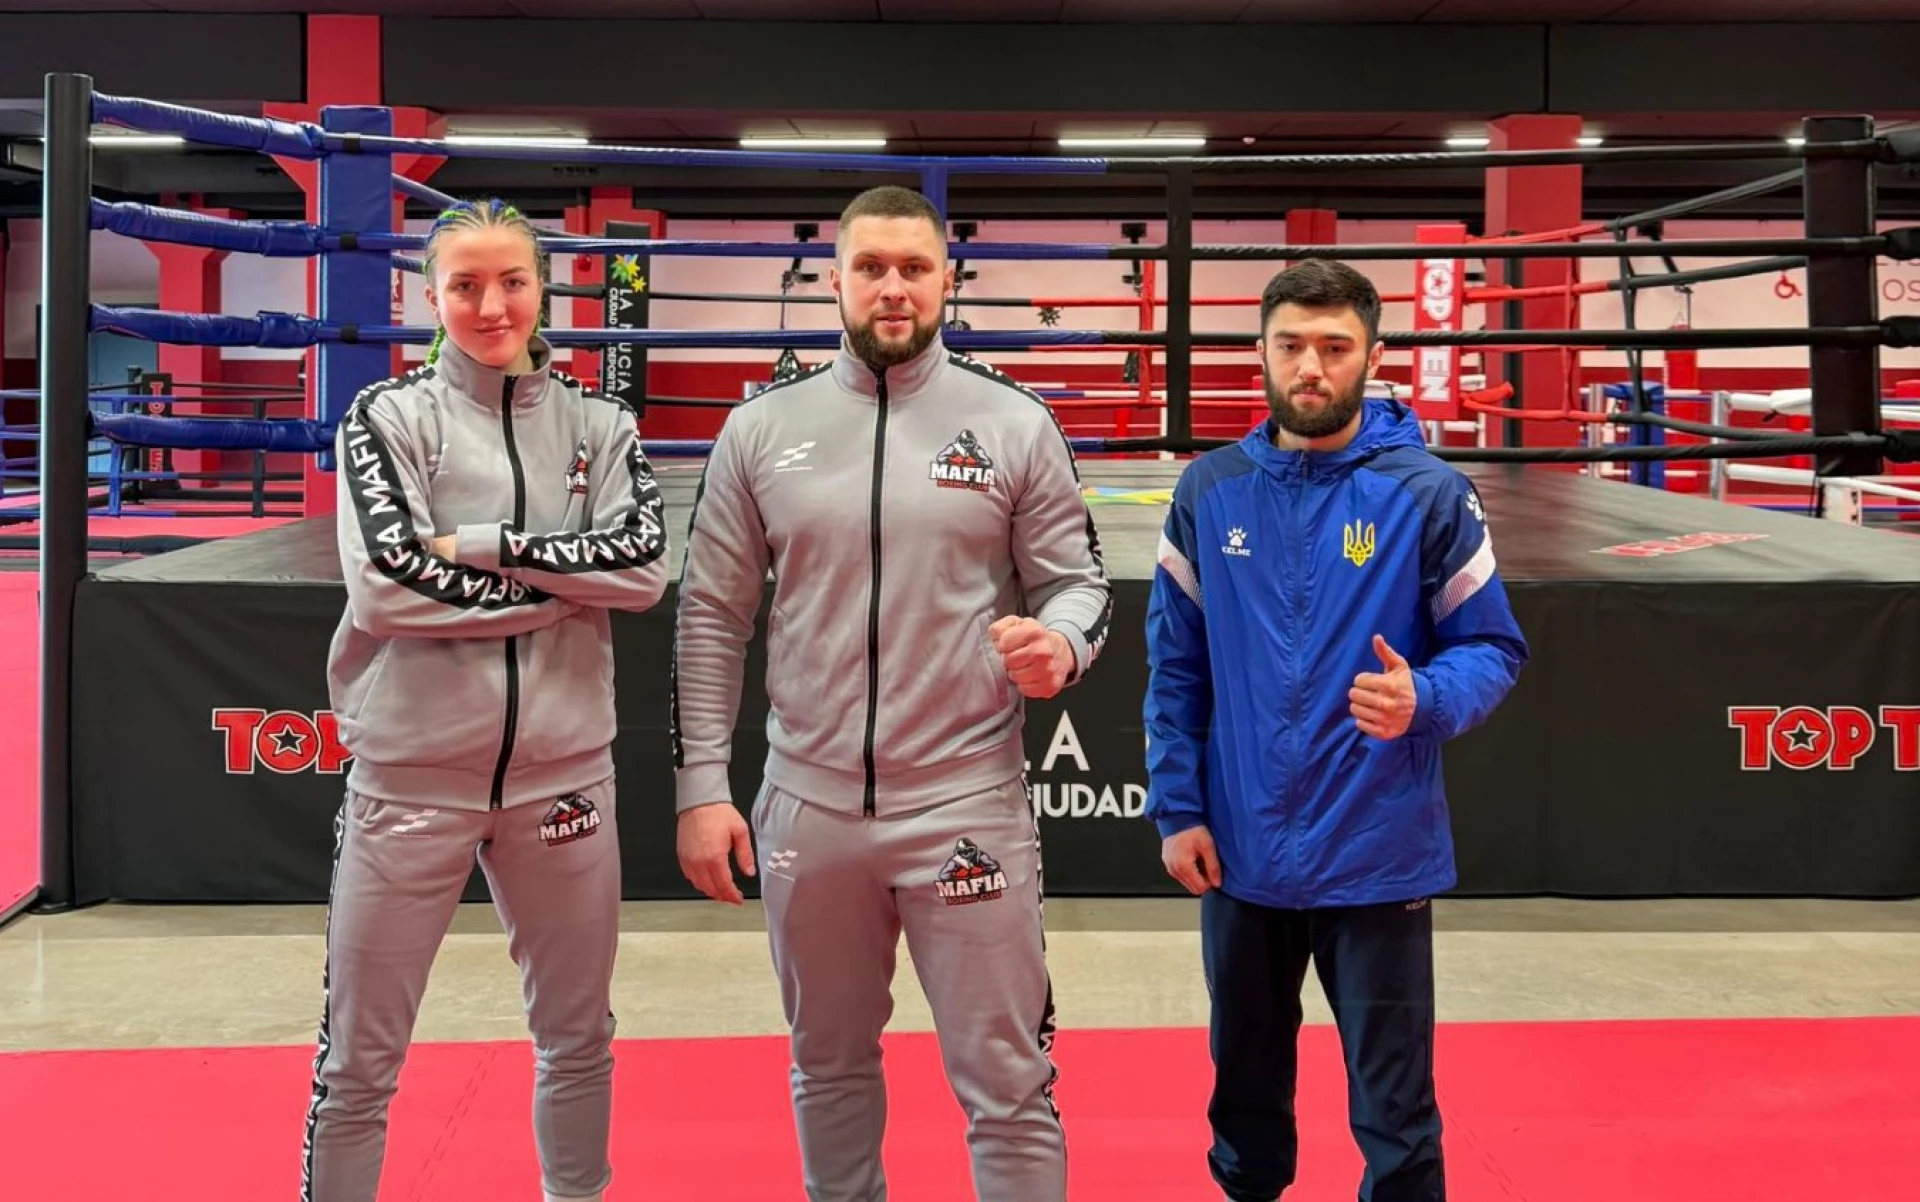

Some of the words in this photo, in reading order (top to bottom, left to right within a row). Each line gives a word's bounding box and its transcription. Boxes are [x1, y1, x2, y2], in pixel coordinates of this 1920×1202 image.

[619, 288, 633, 311] LA
[931, 463, 997, 486] MAFIA
[1728, 706, 1876, 770] TOP
[1032, 783, 1148, 818] IUDAD
[538, 809, 601, 840] MAFIA
[935, 871, 1008, 897] MAFIA
